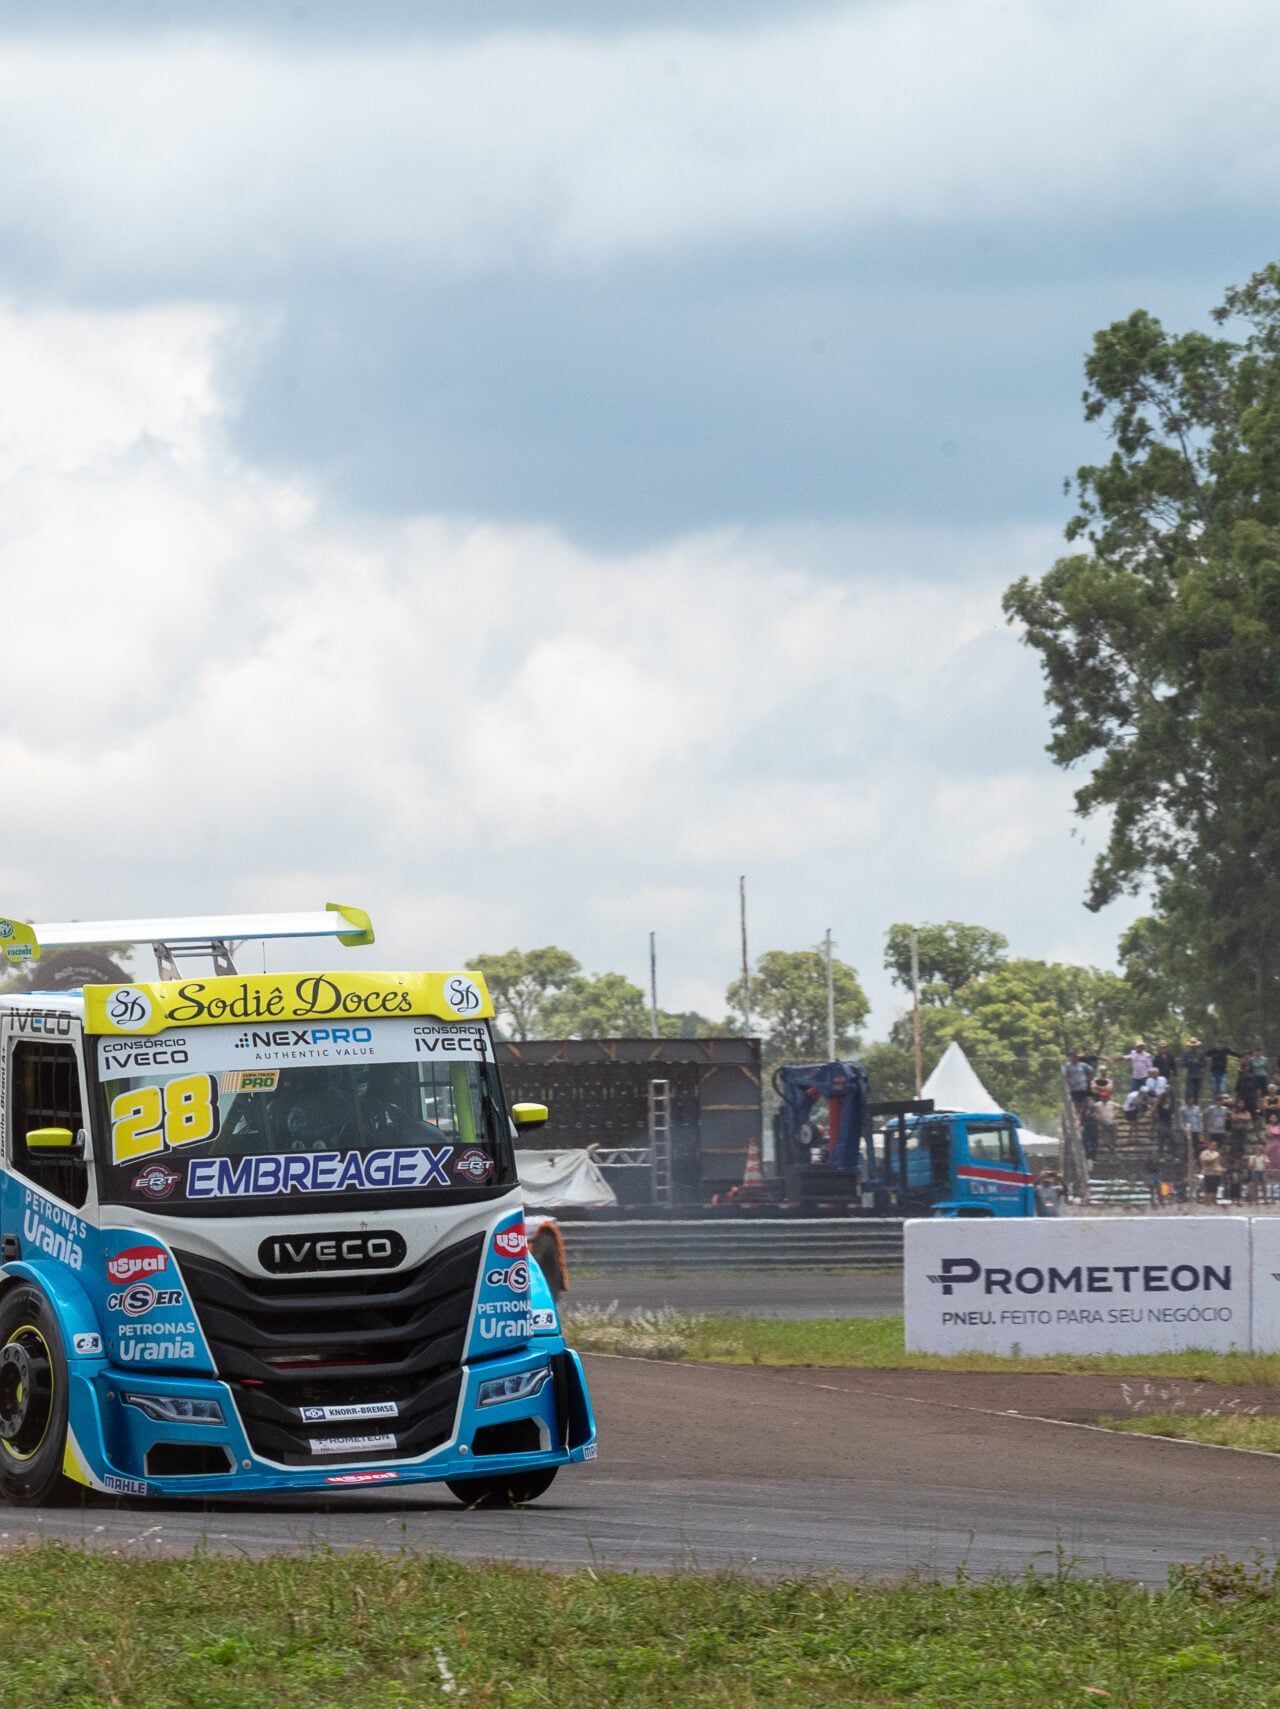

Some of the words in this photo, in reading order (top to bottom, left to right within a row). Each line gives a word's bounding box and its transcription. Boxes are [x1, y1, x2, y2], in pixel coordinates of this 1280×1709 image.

[167, 983, 285, 1021] Sodiê
[293, 974, 412, 1015] Doces
[10, 1007, 71, 1036] IVECO
[414, 1024, 485, 1035] CONSÓRCIO
[103, 1038, 186, 1053] CONSÓRCIO
[252, 1027, 372, 1048] NEXPRO
[415, 1037, 488, 1052] IVECO
[105, 1050, 188, 1070] IVECO
[255, 1049, 329, 1060] AUTHENTIC
[336, 1047, 375, 1056] VALUE
[242, 1077, 275, 1088] PRO
[111, 1073, 220, 1167] 28
[187, 1146, 454, 1198] EMBREAGEX
[457, 1161, 494, 1170] ERT
[135, 1176, 178, 1187] ERT
[25, 1189, 87, 1239] PETRONAS
[24, 1209, 83, 1271] Urania
[274, 1239, 391, 1263] IVECO
[108, 1255, 166, 1278] usual
[926, 1258, 1232, 1295] PROMETEON
[107, 1283, 183, 1317] CISER
[478, 1300, 531, 1314] PETRONA
[942, 1311, 996, 1326] PNEU.
[1000, 1311, 1052, 1325] FEITO
[1057, 1310, 1103, 1324] PARA
[1108, 1309, 1142, 1323] SEU
[1148, 1307, 1232, 1322] NEGÓCIO
[119, 1322, 195, 1336] PETRONAS
[120, 1336, 194, 1361] Urania
[329, 1405, 395, 1416] KNORR-BREMSE
[105, 1475, 146, 1494] MAHLE
